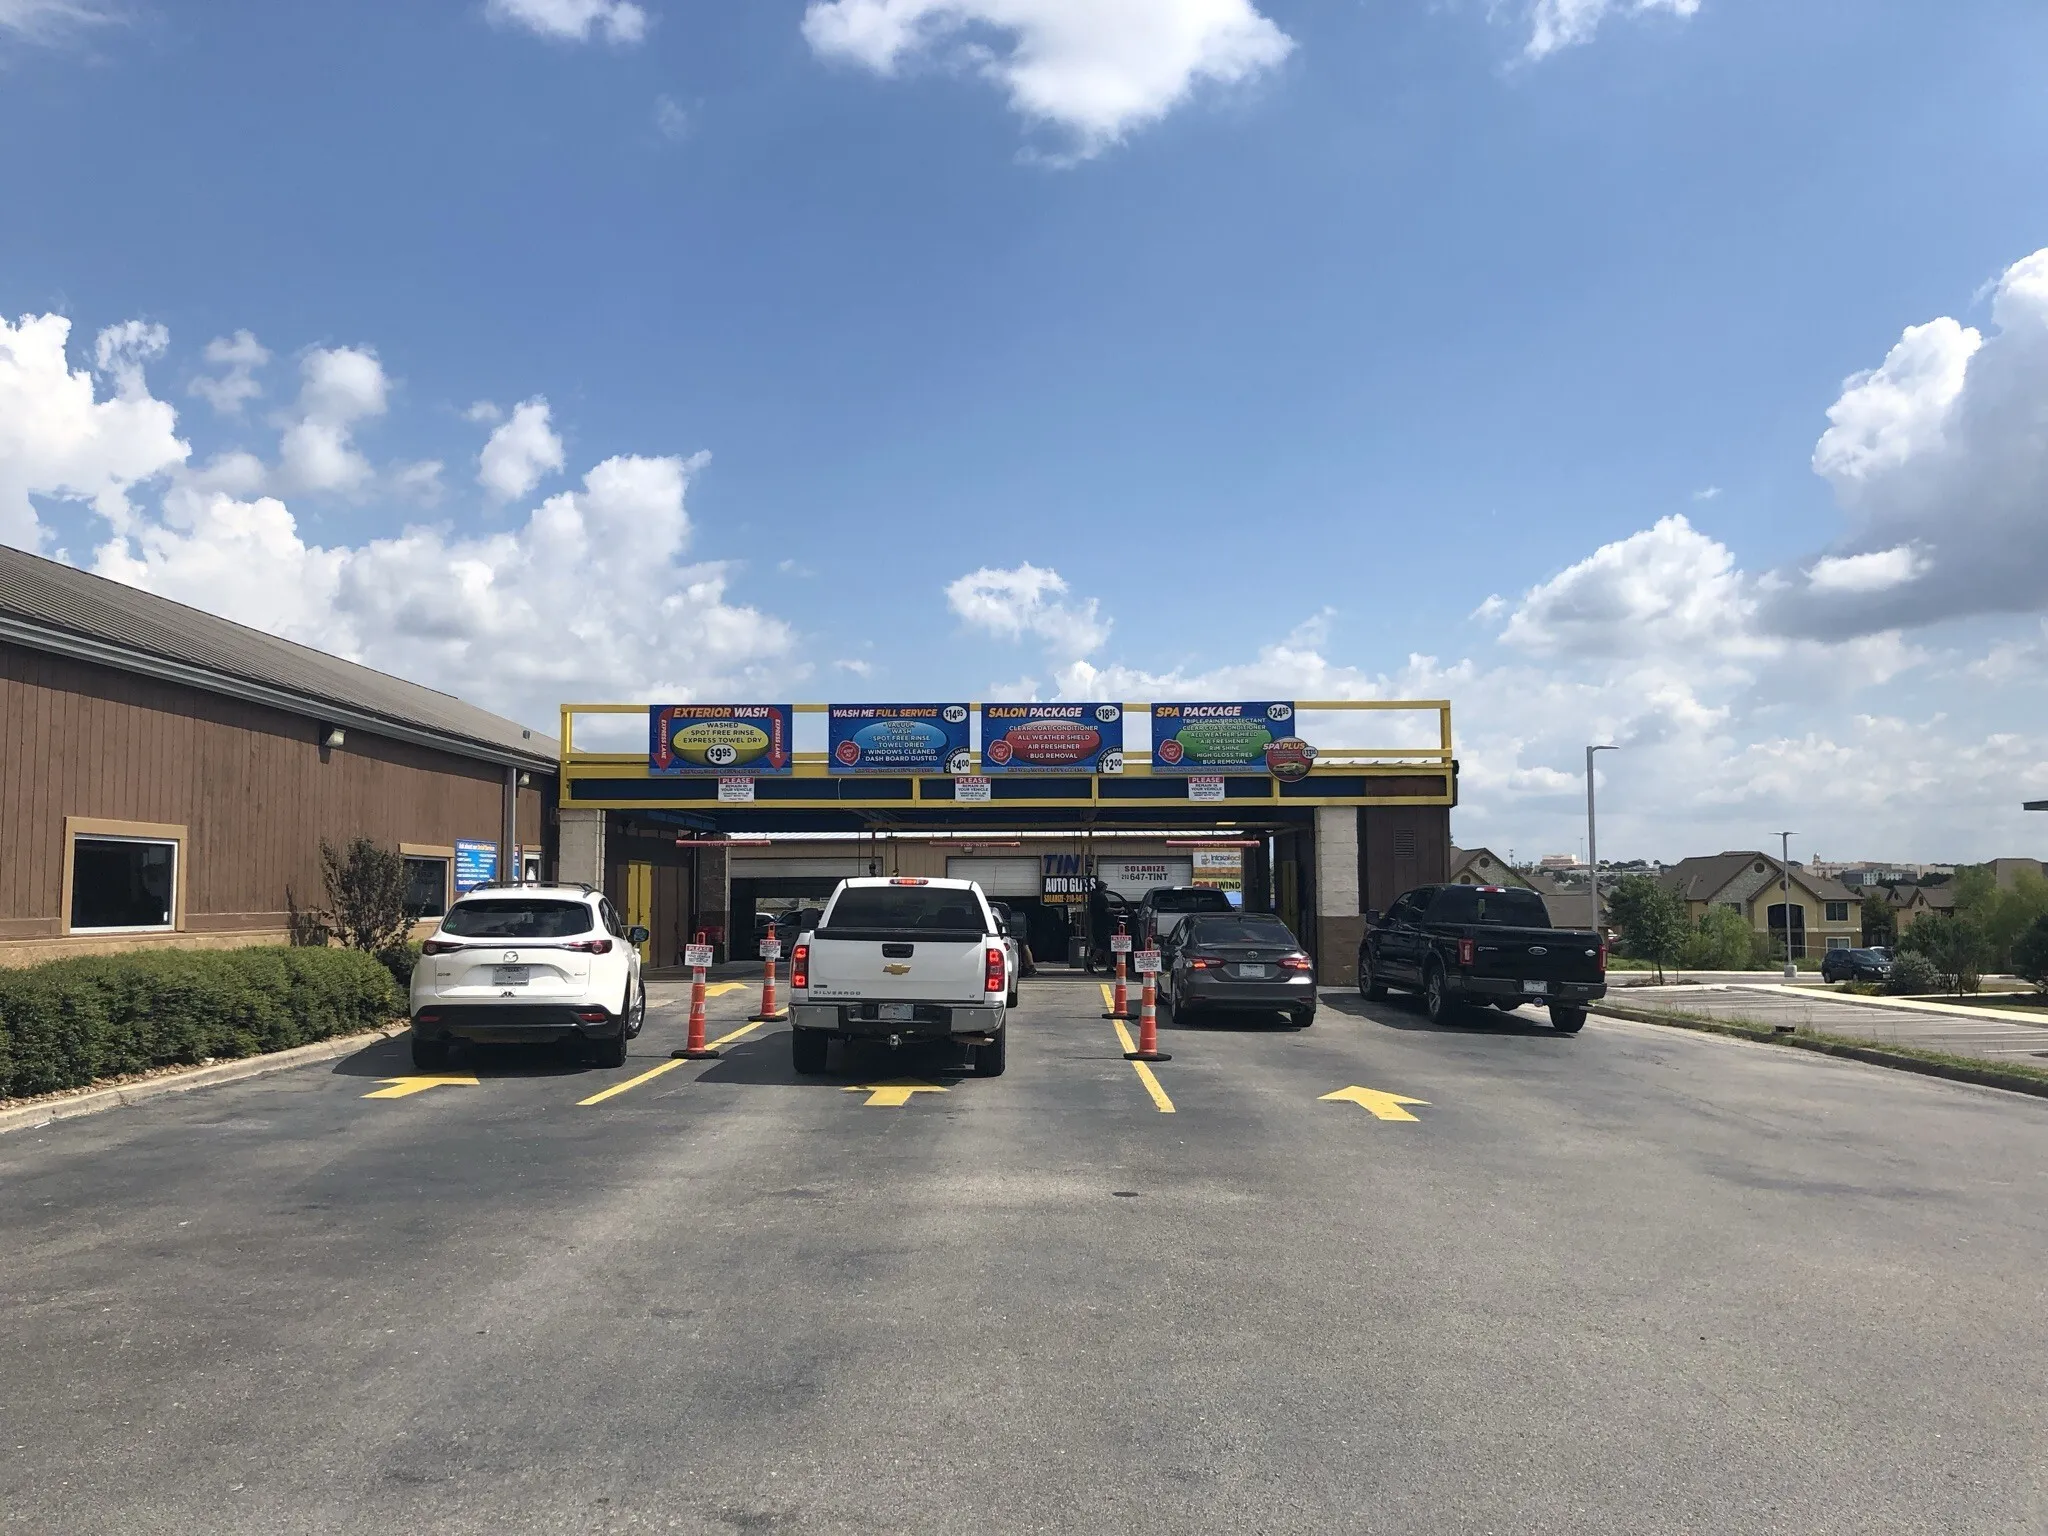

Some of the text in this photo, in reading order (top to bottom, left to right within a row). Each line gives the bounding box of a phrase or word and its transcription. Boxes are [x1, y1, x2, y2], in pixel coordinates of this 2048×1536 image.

[673, 707, 769, 718] EXTERIOR WASH
[833, 708, 938, 718] WASH ME FULL SERVICE
[988, 707, 1082, 717] SALON PACKAGE
[1156, 706, 1242, 717] SPA PACKAGE
[1046, 878, 1067, 892] AUTO
